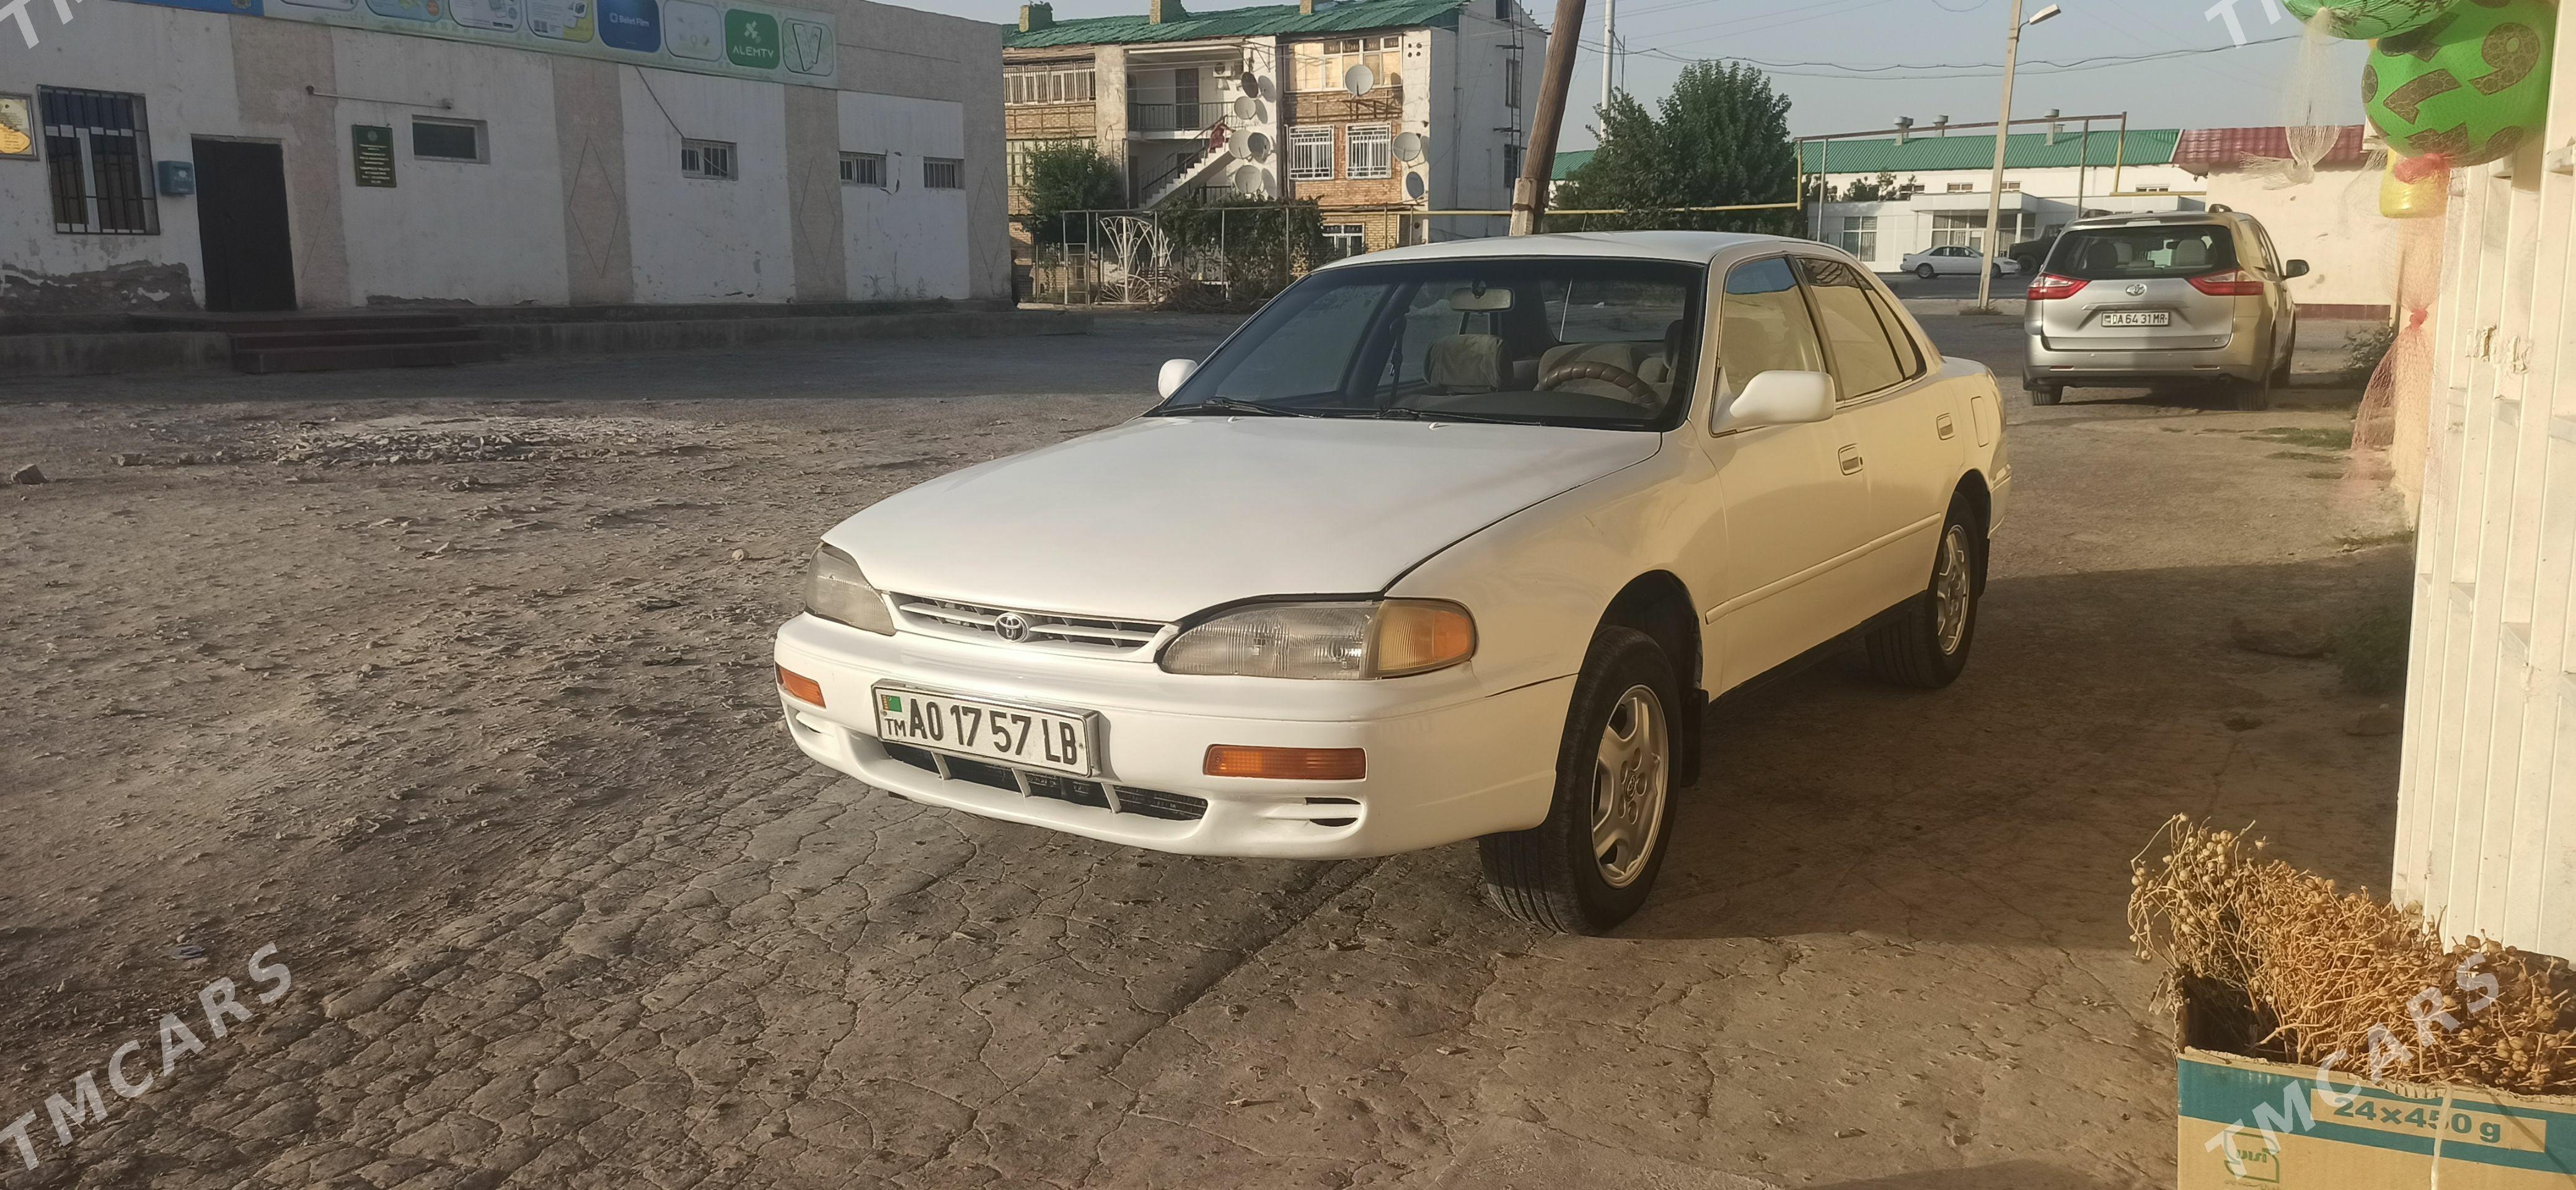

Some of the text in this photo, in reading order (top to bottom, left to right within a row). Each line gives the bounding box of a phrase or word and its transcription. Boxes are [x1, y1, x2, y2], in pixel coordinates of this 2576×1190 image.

[2125, 314, 2138, 324] 64
[2141, 314, 2151, 324] 31
[2153, 314, 2165, 324] MR
[884, 718, 907, 737] TM
[950, 705, 981, 747] 17
[989, 710, 1031, 756] 57
[1041, 718, 1077, 765] LB
[2479, 1121, 2501, 1143] g
